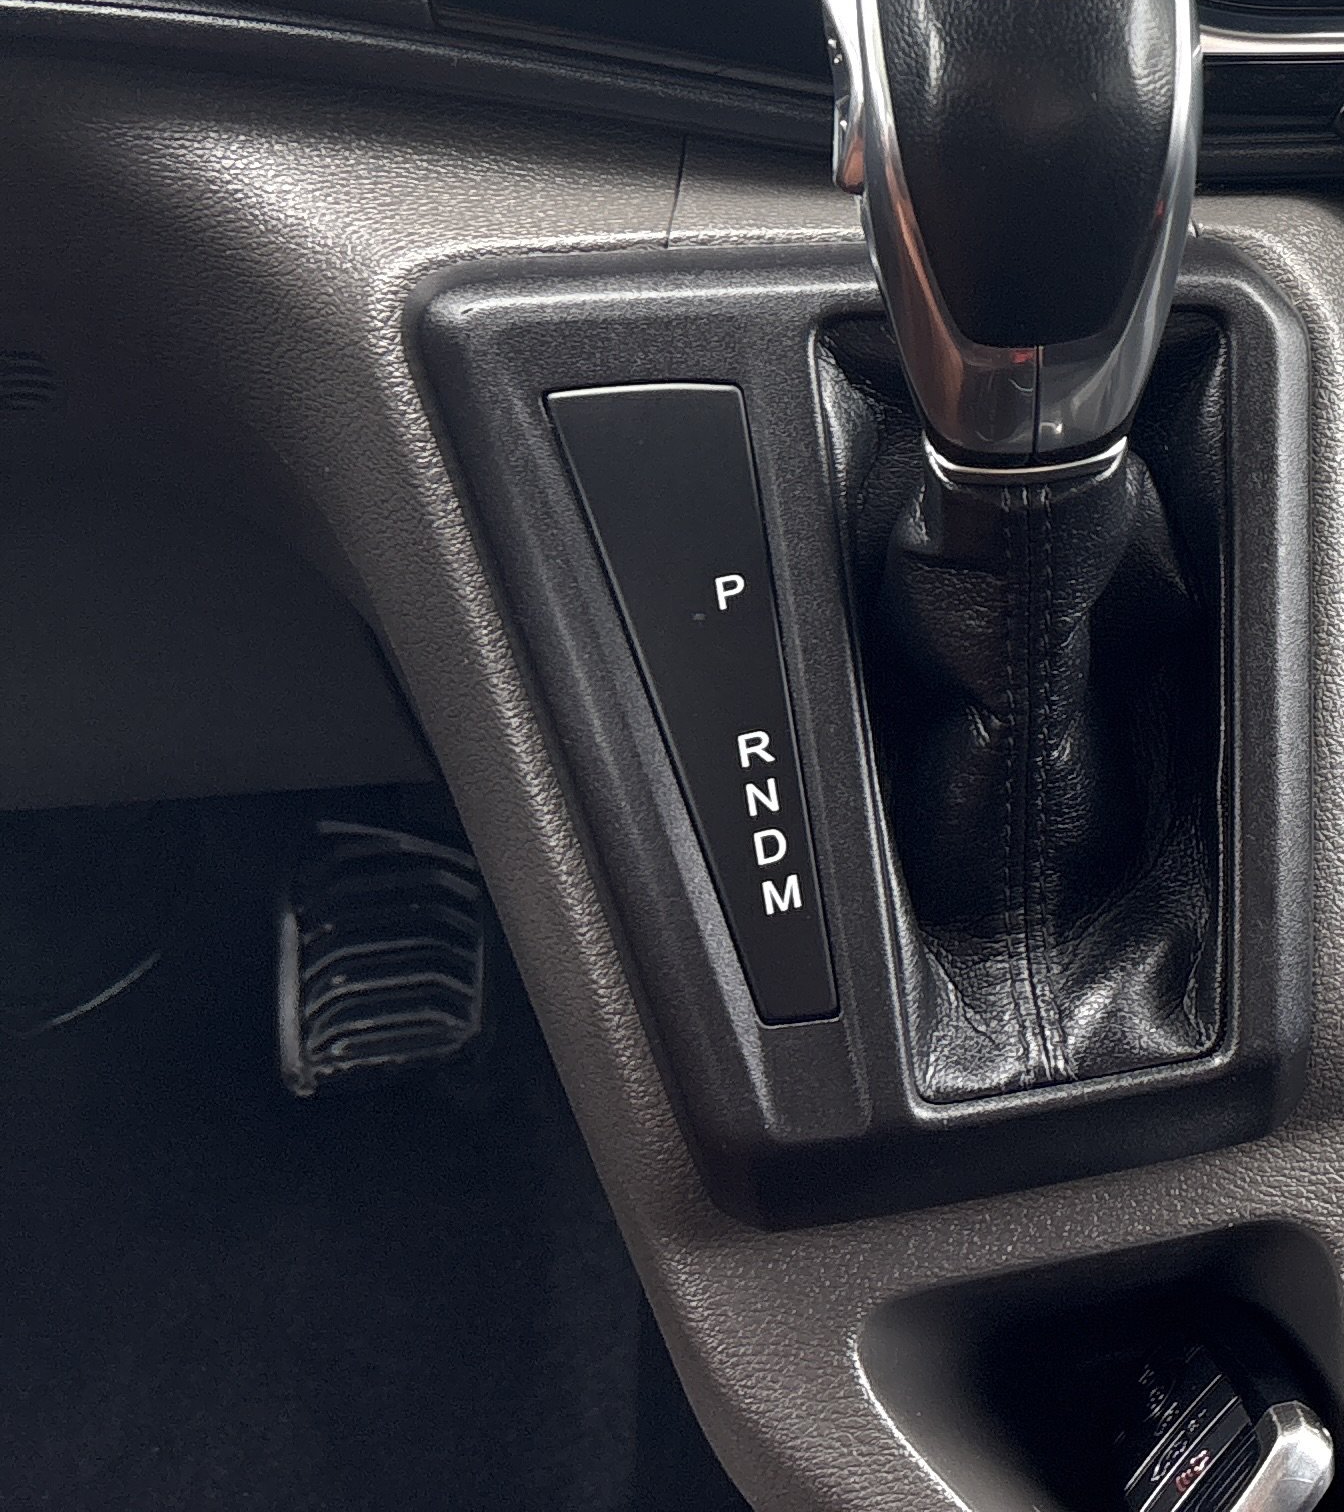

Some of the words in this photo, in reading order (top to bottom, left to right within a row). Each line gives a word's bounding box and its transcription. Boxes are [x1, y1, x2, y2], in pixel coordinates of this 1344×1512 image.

[714, 574, 745, 611] P
[737, 730, 776, 768] R
[745, 777, 780, 817] N
[753, 828, 787, 866] D
[761, 874, 802, 915] M
